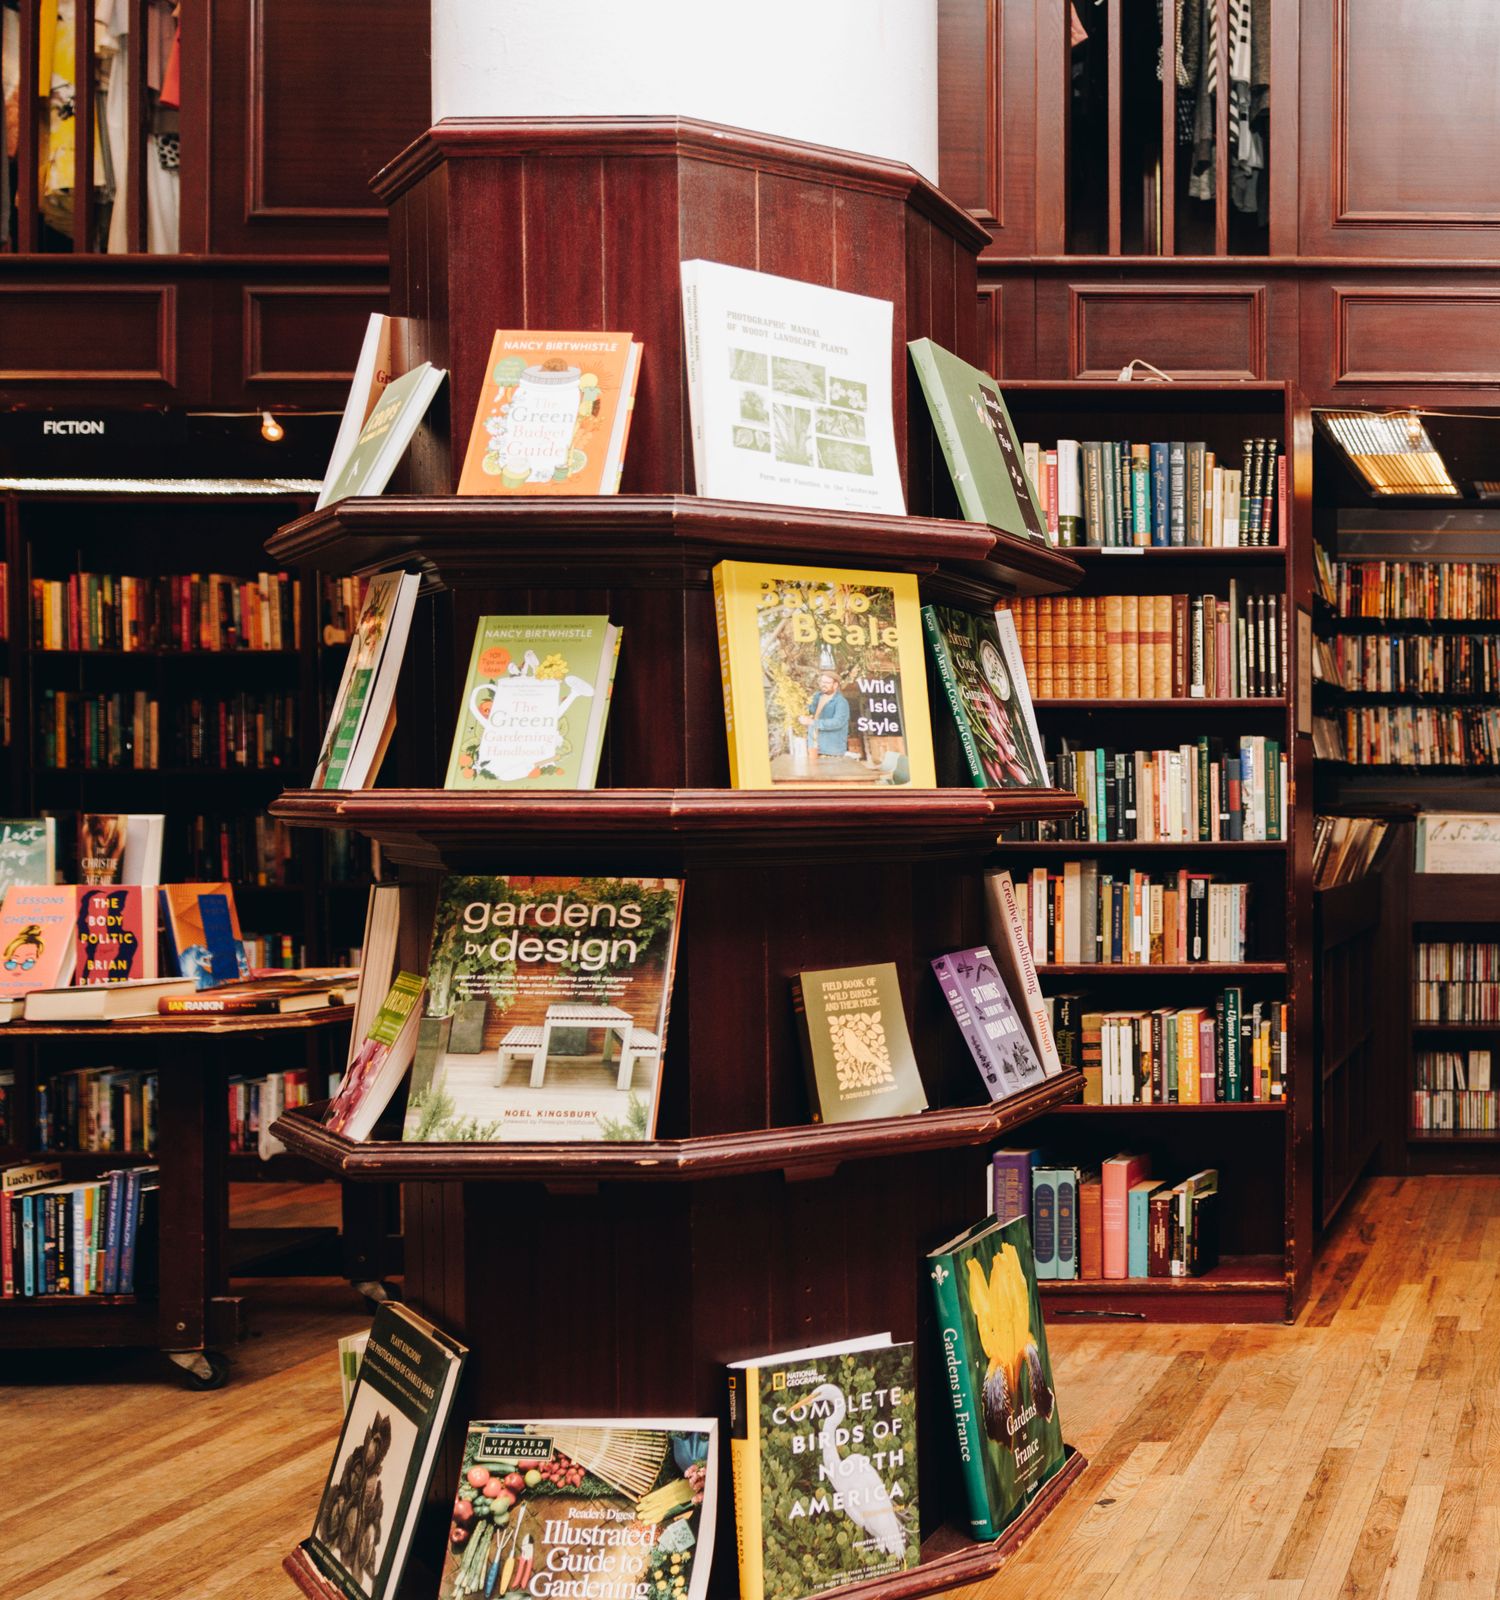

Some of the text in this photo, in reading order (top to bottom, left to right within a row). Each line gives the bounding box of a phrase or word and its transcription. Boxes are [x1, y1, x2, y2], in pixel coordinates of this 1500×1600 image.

[727, 311, 822, 339] PHOTOGRAPHIC MANUAL
[504, 341, 619, 352] NANCY BIRTWHISTLE
[727, 322, 849, 356] OF WOODY LANDSCAPE PLANTS
[511, 407, 573, 423] Green
[44, 421, 104, 435] FICTION
[513, 425, 565, 441] Budget
[507, 442, 565, 457] Guide
[1135, 472, 1146, 533] SONS AND LOVERS
[760, 578, 871, 620] Banjo
[485, 629, 593, 638] NANCY BIRTWHISTLE
[792, 612, 899, 648] Beale
[857, 678, 896, 694] Wild
[512, 700, 538, 712] The
[869, 698, 897, 713] Isle
[490, 710, 554, 728] Green
[857, 717, 899, 736] Style
[484, 731, 554, 743] Gardening
[486, 746, 545, 757] Handbook
[3, 825, 42, 843] Last
[82, 858, 118, 870] CHRISTIE
[93, 898, 119, 909] THE
[4, 916, 65, 924] CHEMISTRY
[88, 916, 124, 927] BODY
[462, 895, 642, 934] gardens
[81, 934, 133, 944] POLITIC
[465, 930, 637, 971] by design
[87, 959, 128, 970] BRIAN
[1001, 880, 1052, 1054] Creative Bookbinding Johnson
[822, 977, 877, 992] FIELD BOOK OF
[828, 989, 872, 1001] WILD BIRDS
[825, 997, 881, 1012] AND THEIR MUSIC
[1227, 1009, 1237, 1077] Ulysses Annotated
[504, 1109, 599, 1119] NOEL KINGSBURY
[6, 1167, 60, 1187] Lucky Dogs
[108, 1212, 116, 1246] AVALON
[123, 1212, 132, 1246] AVALON
[390, 1333, 422, 1366] PLANT KINGDOMS
[405, 1364, 423, 1391] CHARLES
[421, 1377, 436, 1400] JONES
[786, 1369, 818, 1381] NATIONAL
[786, 1374, 827, 1388] GEOGRAPHIC
[942, 1328, 971, 1462] Gardens in France
[772, 1386, 902, 1425] COMPLETE
[1006, 1402, 1038, 1437] Gardens
[492, 1438, 544, 1448] UPDATED
[792, 1418, 903, 1455] BIRDS OF
[1021, 1432, 1028, 1441] in
[485, 1445, 548, 1457] WITH COLOR
[1014, 1437, 1040, 1469] France
[818, 1449, 905, 1482] NORTH
[788, 1481, 905, 1520] AMERICA
[568, 1508, 636, 1521] Reader's Digest
[541, 1520, 658, 1548] Illustrated
[546, 1547, 643, 1573] Guide to
[529, 1572, 651, 1600] Gardening
